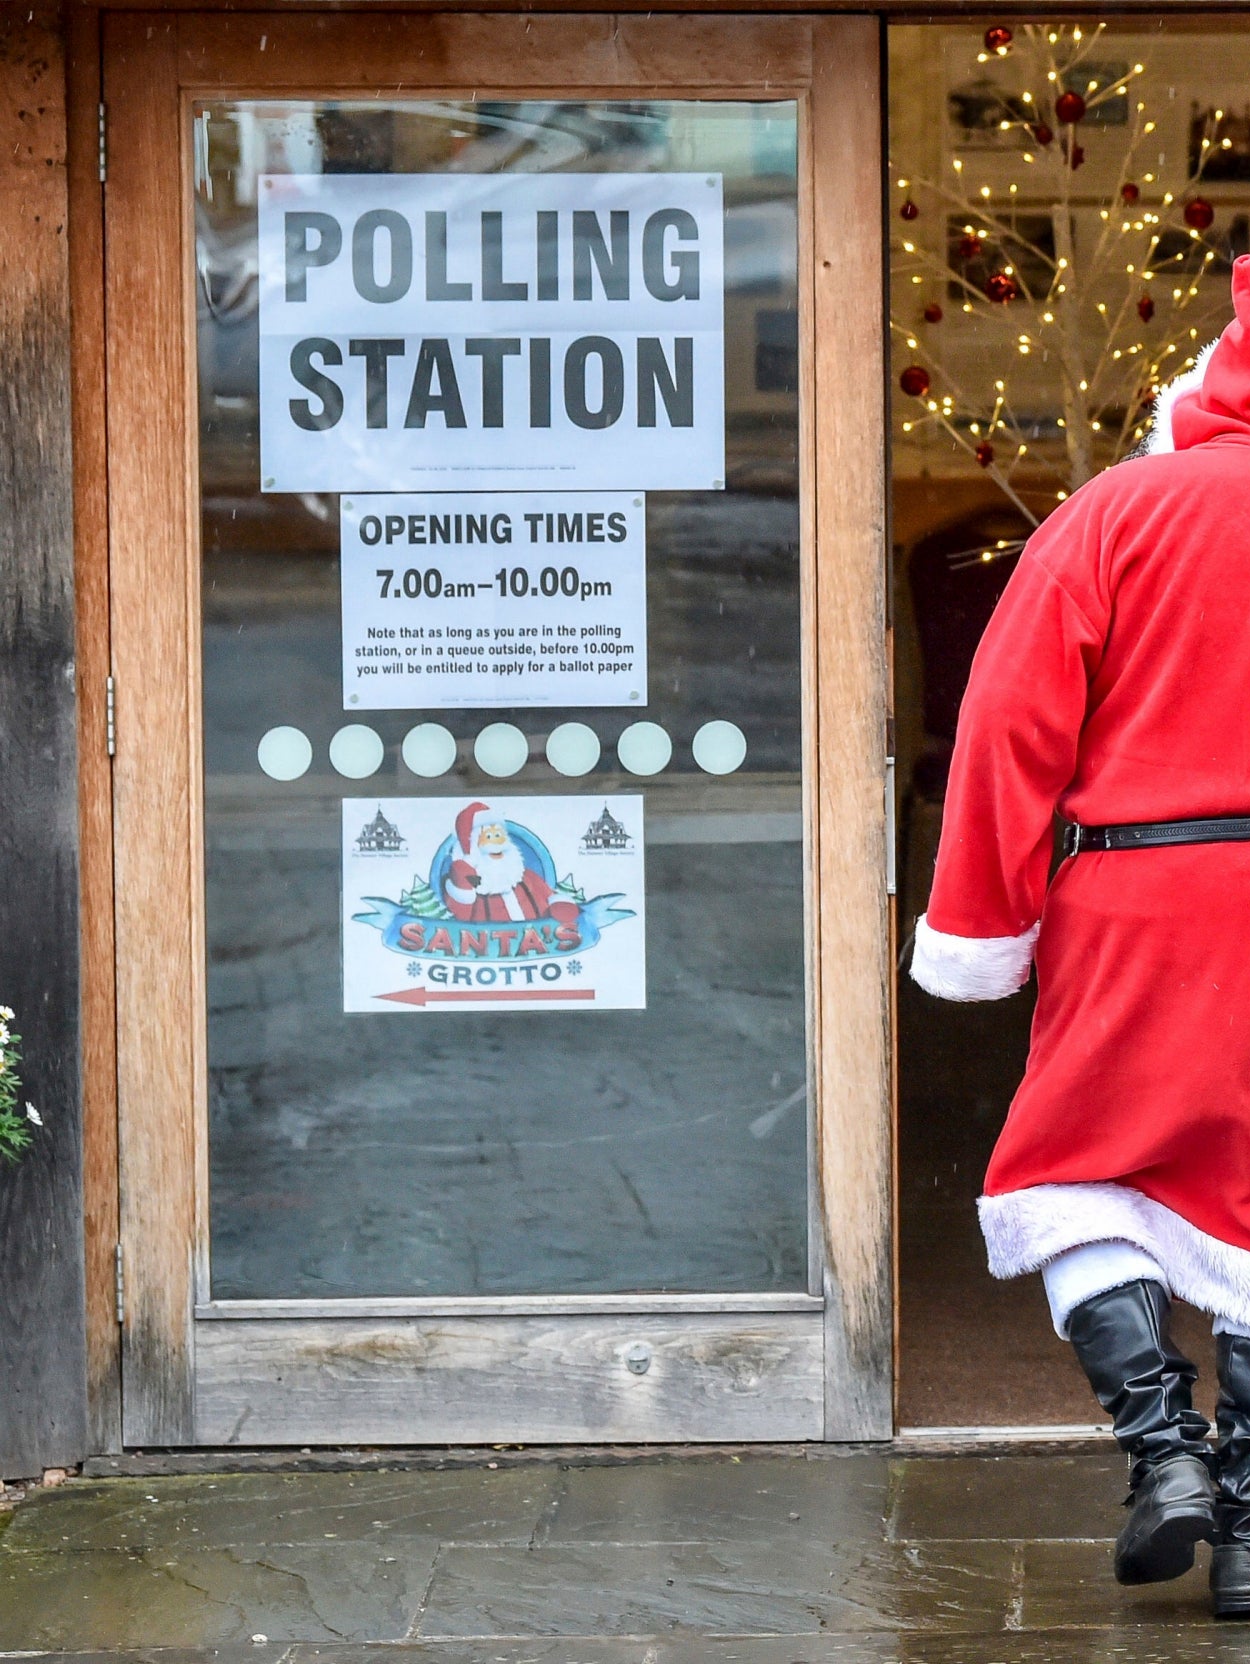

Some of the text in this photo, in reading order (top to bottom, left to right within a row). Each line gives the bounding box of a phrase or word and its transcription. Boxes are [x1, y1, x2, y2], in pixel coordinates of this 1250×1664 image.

[284, 208, 701, 304] POLLING
[289, 335, 694, 431] STATION
[359, 512, 628, 546] OPENING TIMES
[367, 624, 621, 640] Note that as long as you are in the polling
[355, 642, 634, 658] station, or in a queue outside, before 10.00pm
[357, 660, 633, 678] you will be entitled to apply for a ballot paper
[396, 921, 583, 958] SANTA'S
[427, 962, 562, 987] GROTTO
